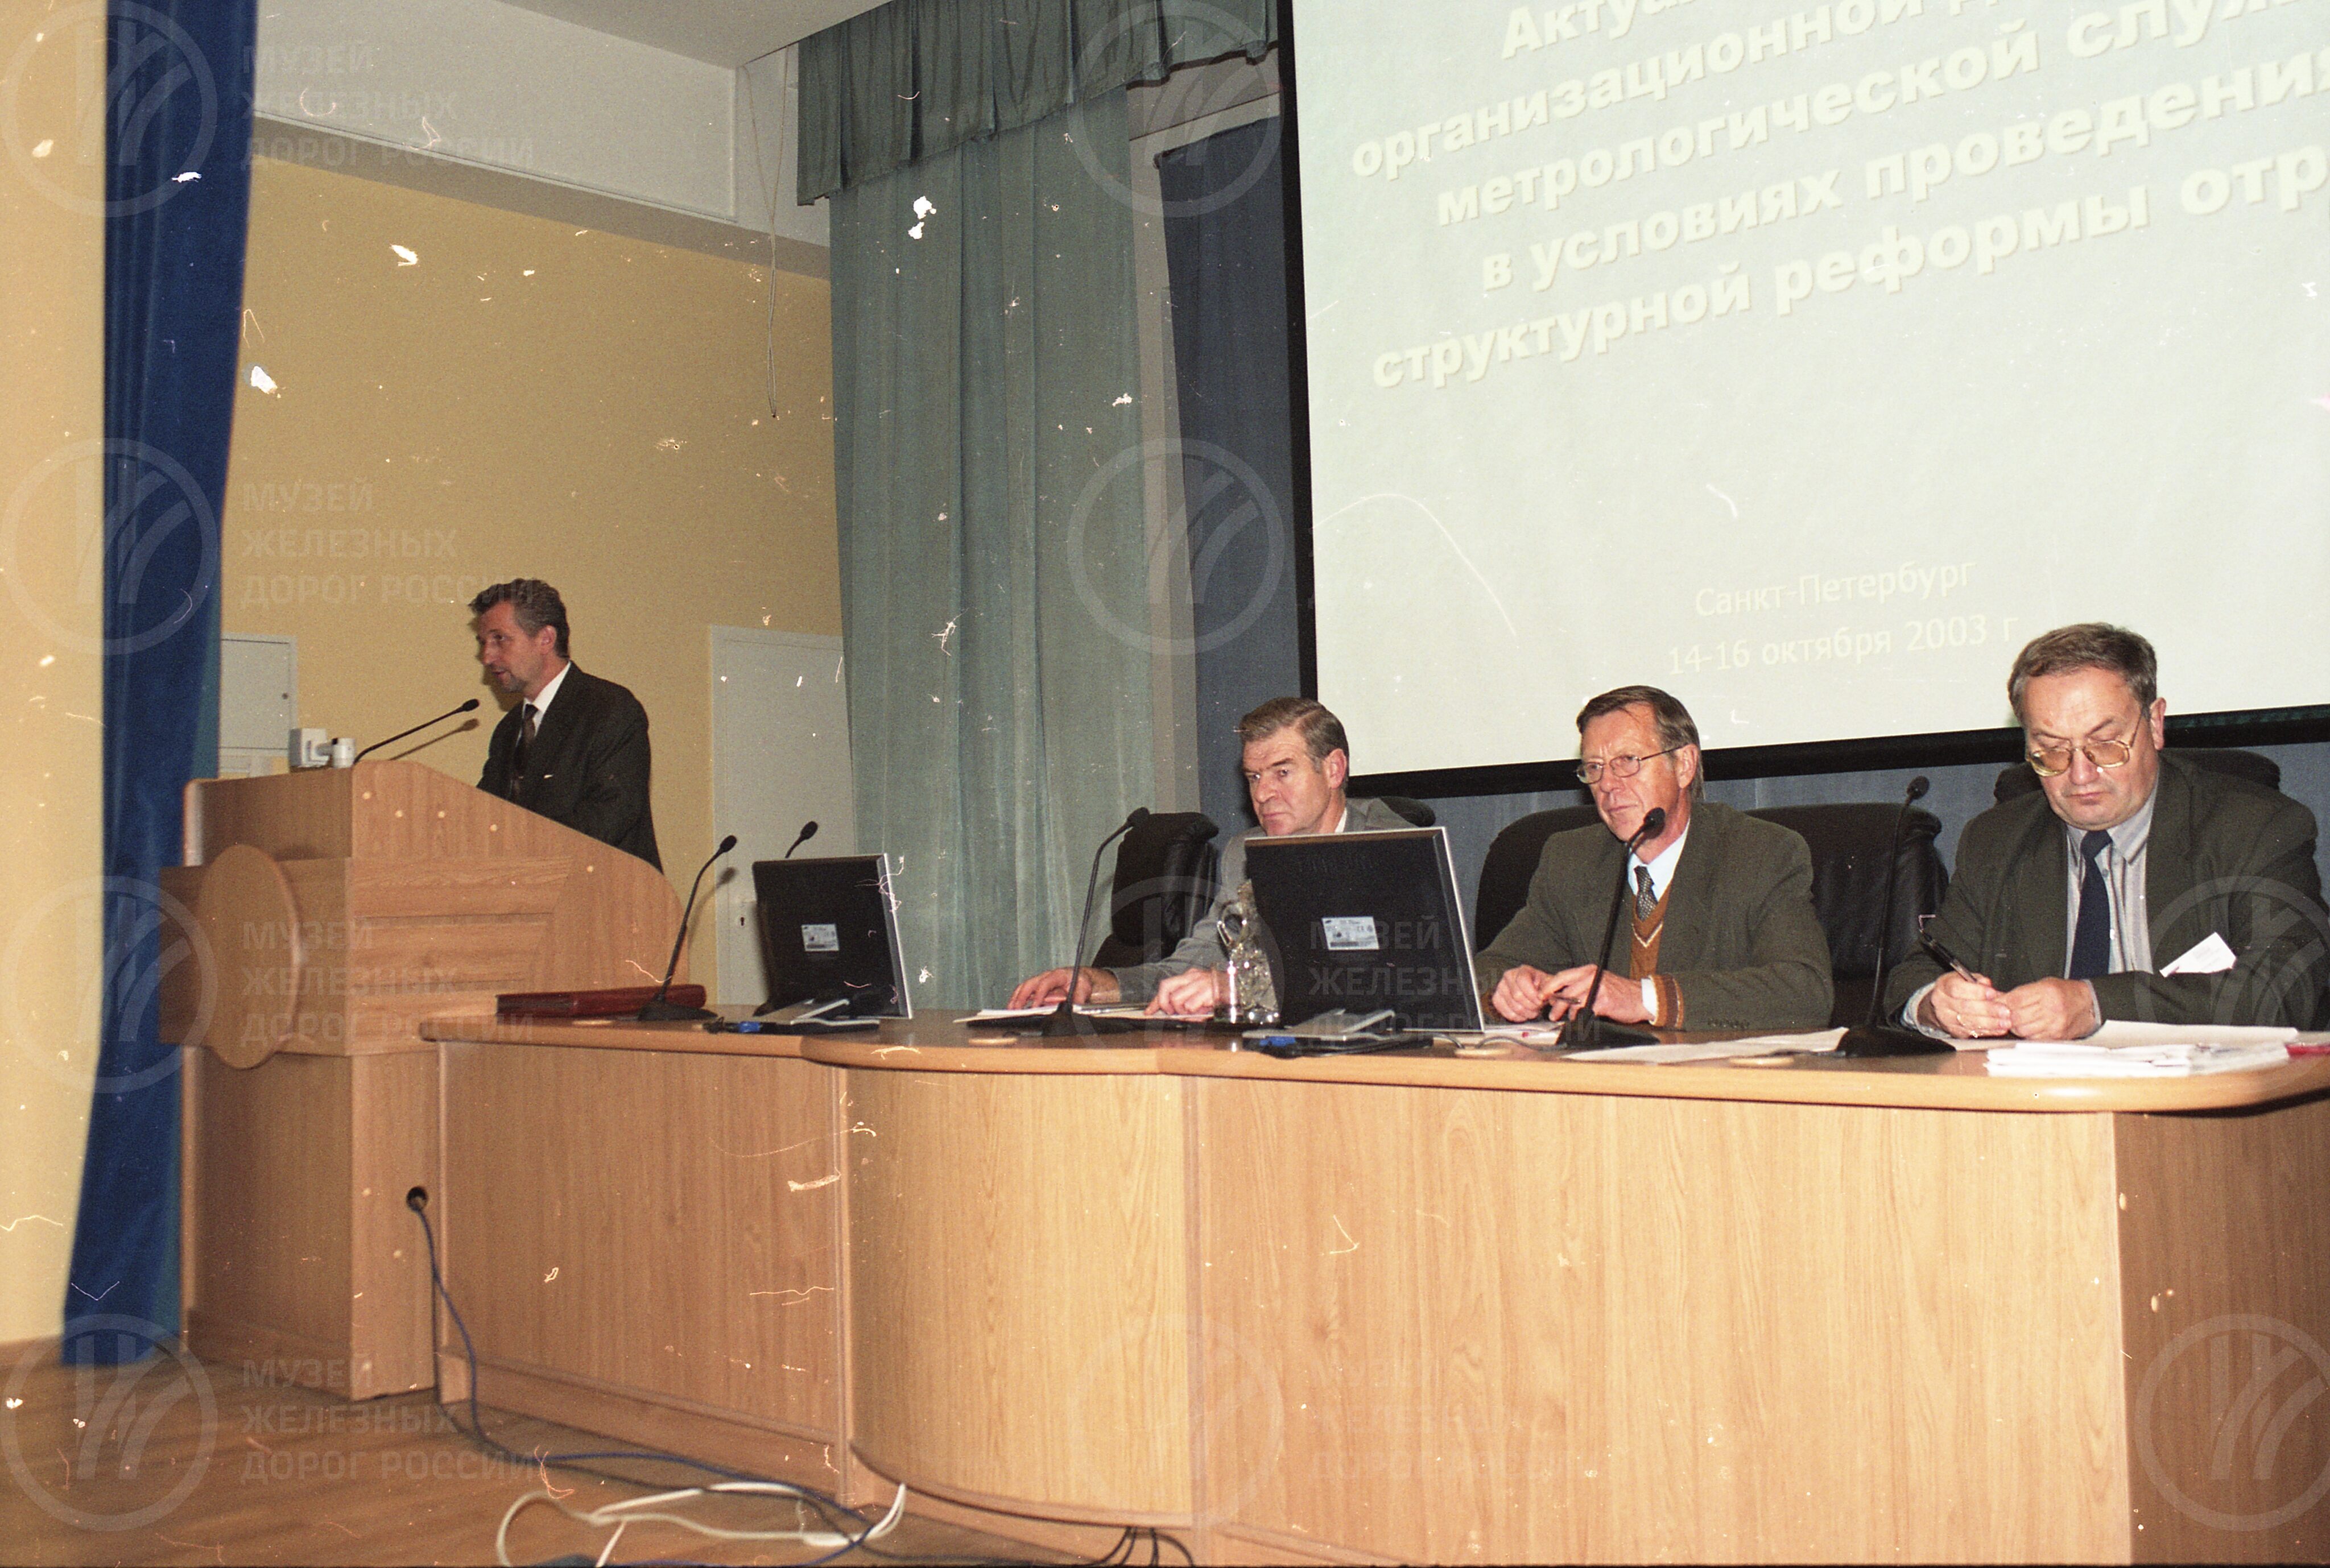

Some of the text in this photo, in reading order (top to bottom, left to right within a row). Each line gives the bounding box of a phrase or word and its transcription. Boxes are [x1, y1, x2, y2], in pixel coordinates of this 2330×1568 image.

[1437, 18, 2039, 226] метрологической
[1483, 47, 2330, 292] в условиях проведени
[1372, 262, 1751, 389] структурной
[1774, 185, 2150, 316] реформы
[1669, 639, 1750, 675] 14-16
[1762, 626, 1891, 664] октября
[1907, 614, 1987, 652] 2003
[1695, 561, 1977, 617] Санкт-Петербург
